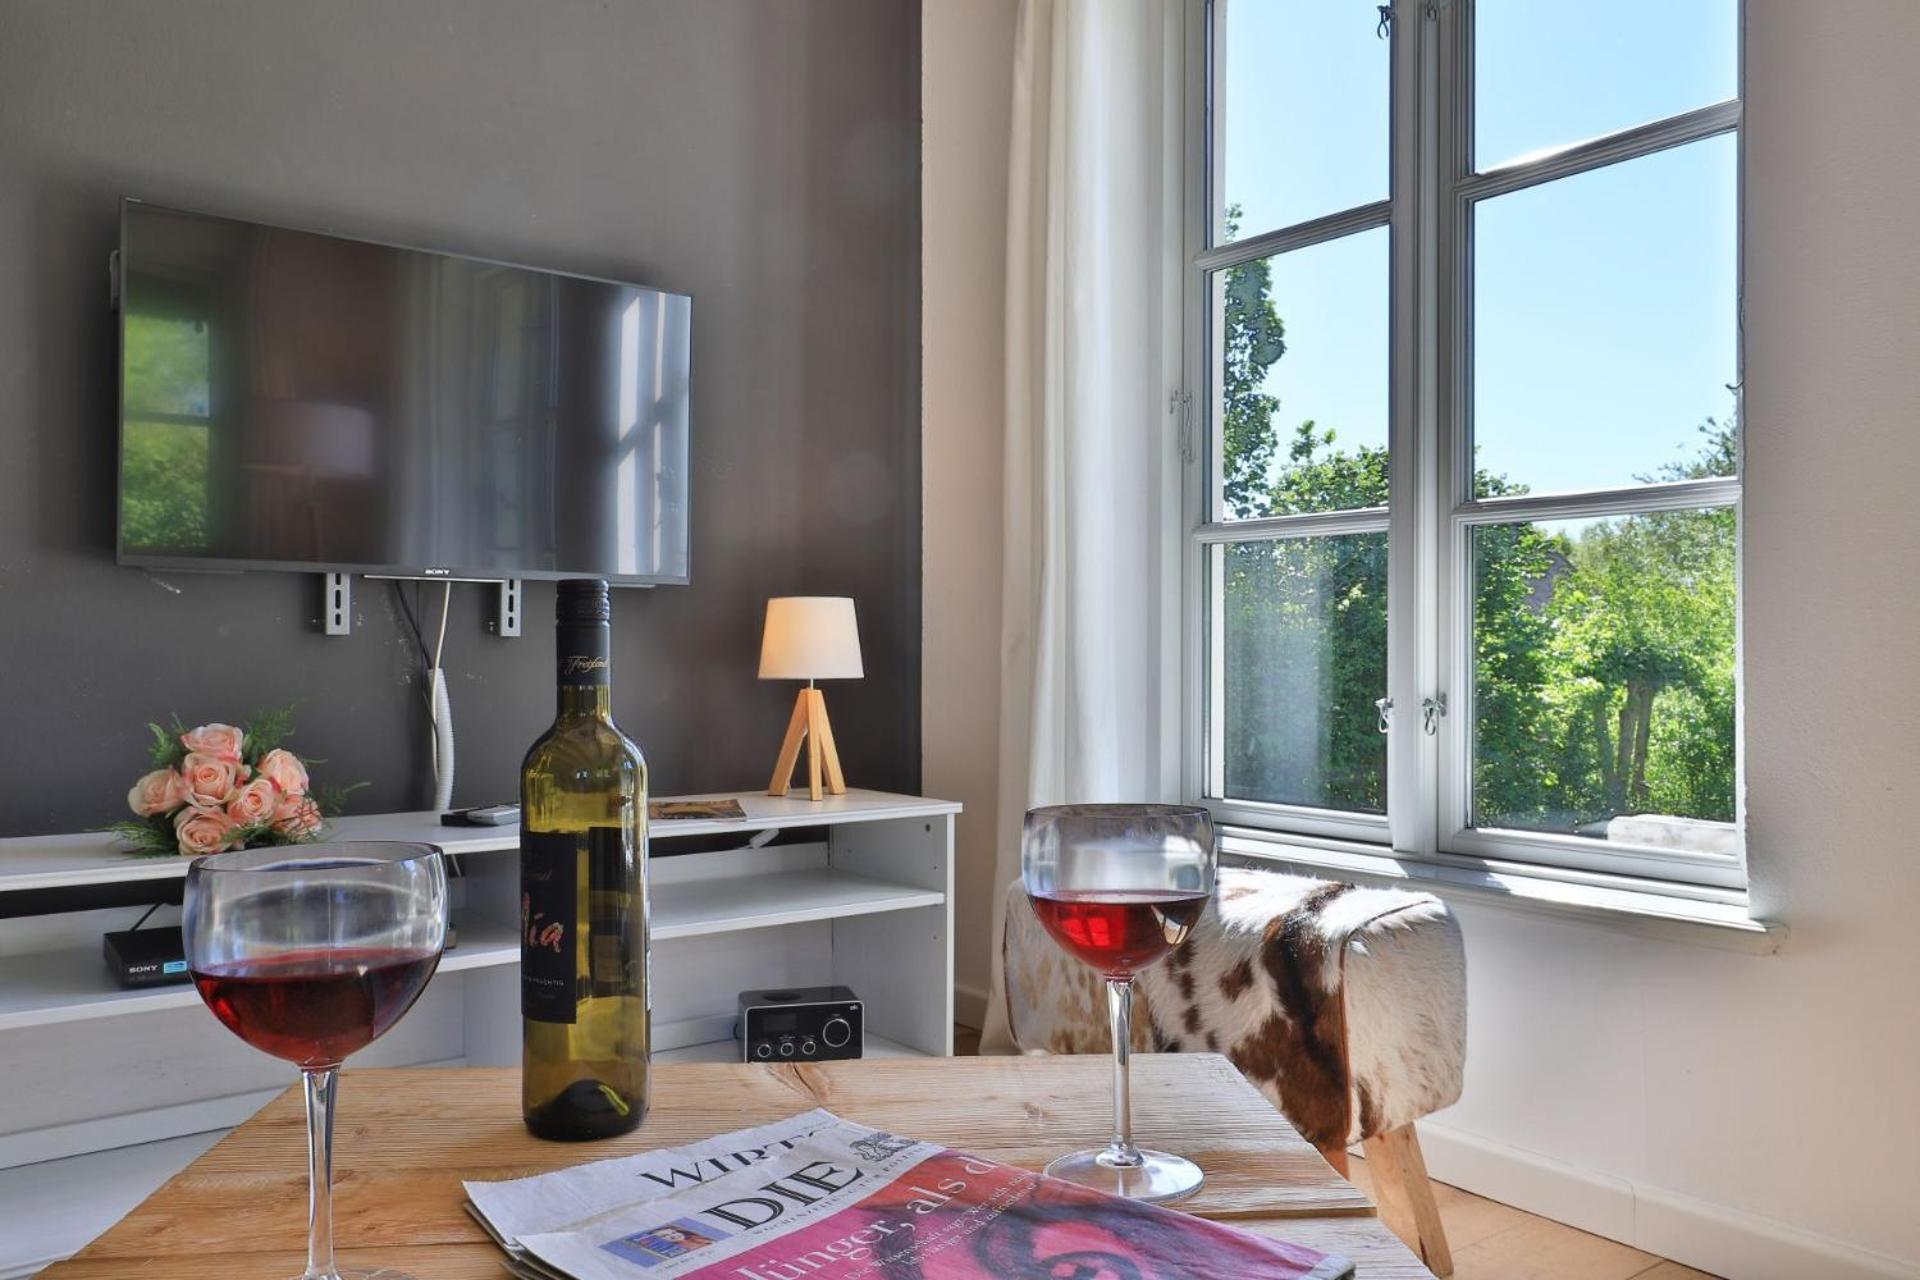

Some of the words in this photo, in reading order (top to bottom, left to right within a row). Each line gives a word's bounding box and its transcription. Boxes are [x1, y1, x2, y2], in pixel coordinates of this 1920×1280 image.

[128, 965, 158, 974] SONY
[640, 1131, 815, 1188] WIRT
[698, 1161, 864, 1231] DIE
[907, 1178, 967, 1215] als
